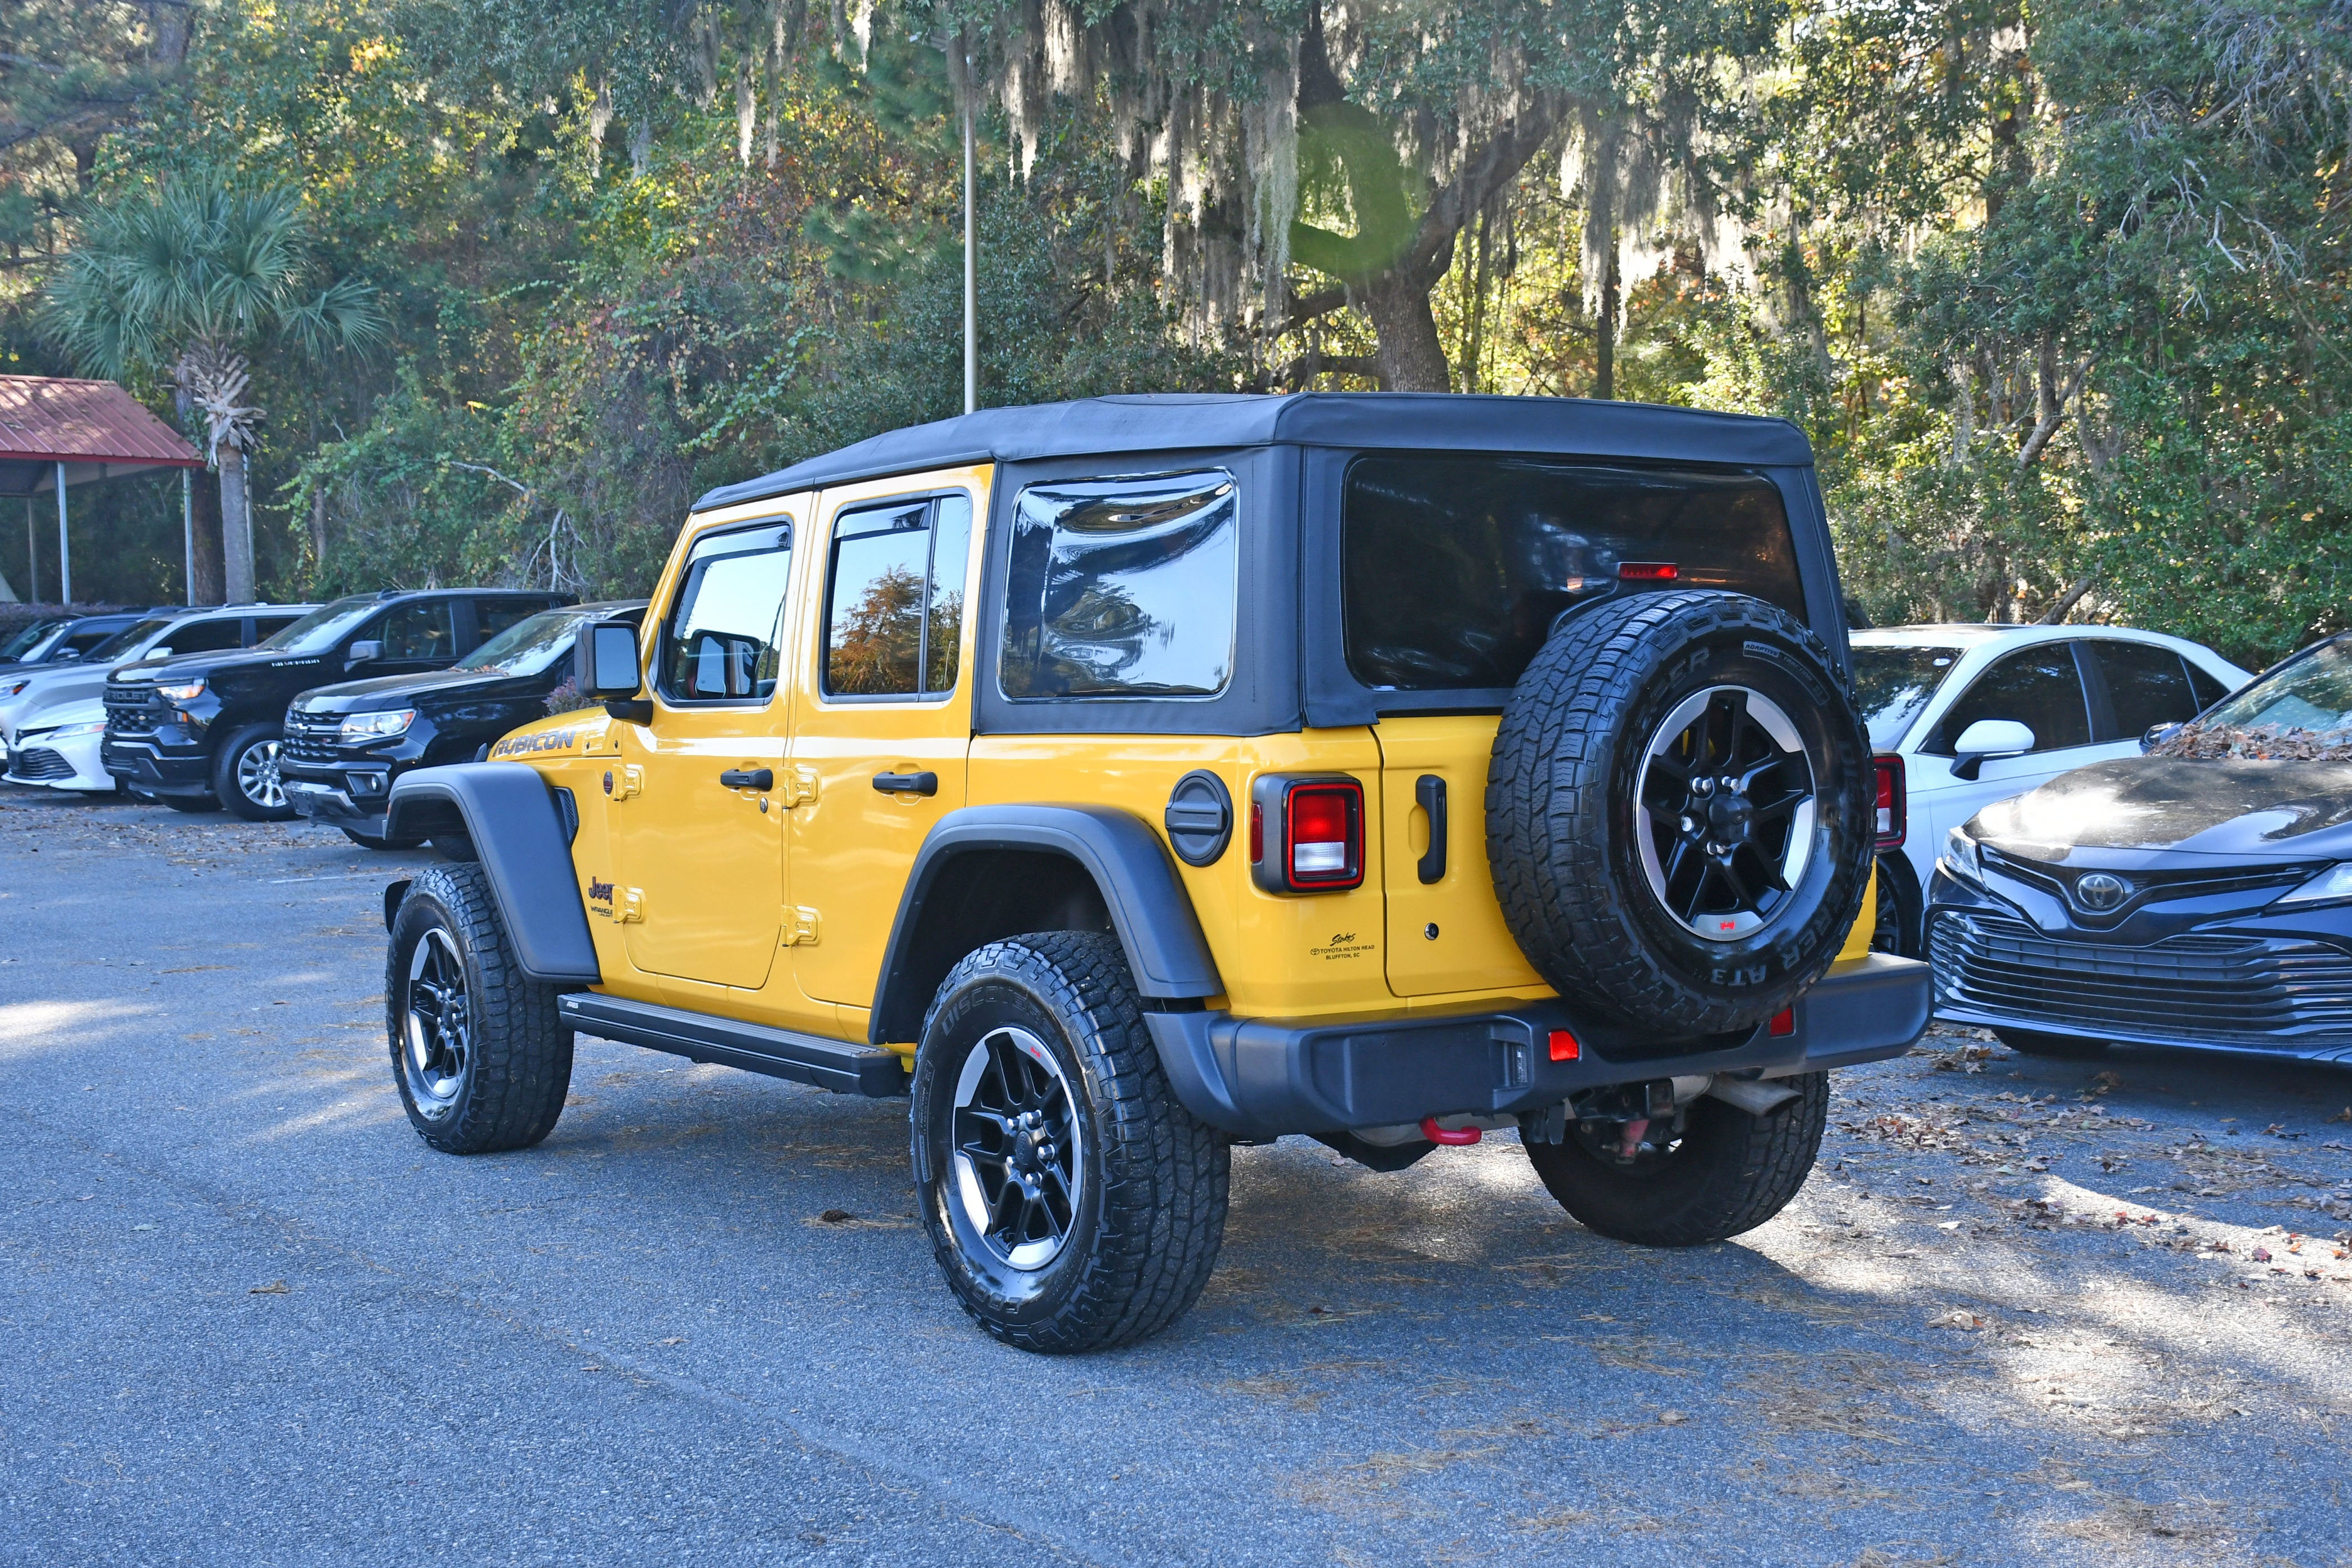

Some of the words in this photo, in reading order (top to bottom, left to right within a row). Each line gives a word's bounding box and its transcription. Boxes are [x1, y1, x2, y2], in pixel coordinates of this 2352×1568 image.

[492, 730, 577, 757] RUBICON
[590, 906, 613, 915] WRANGLE
[1330, 932, 1356, 947] Stokes
